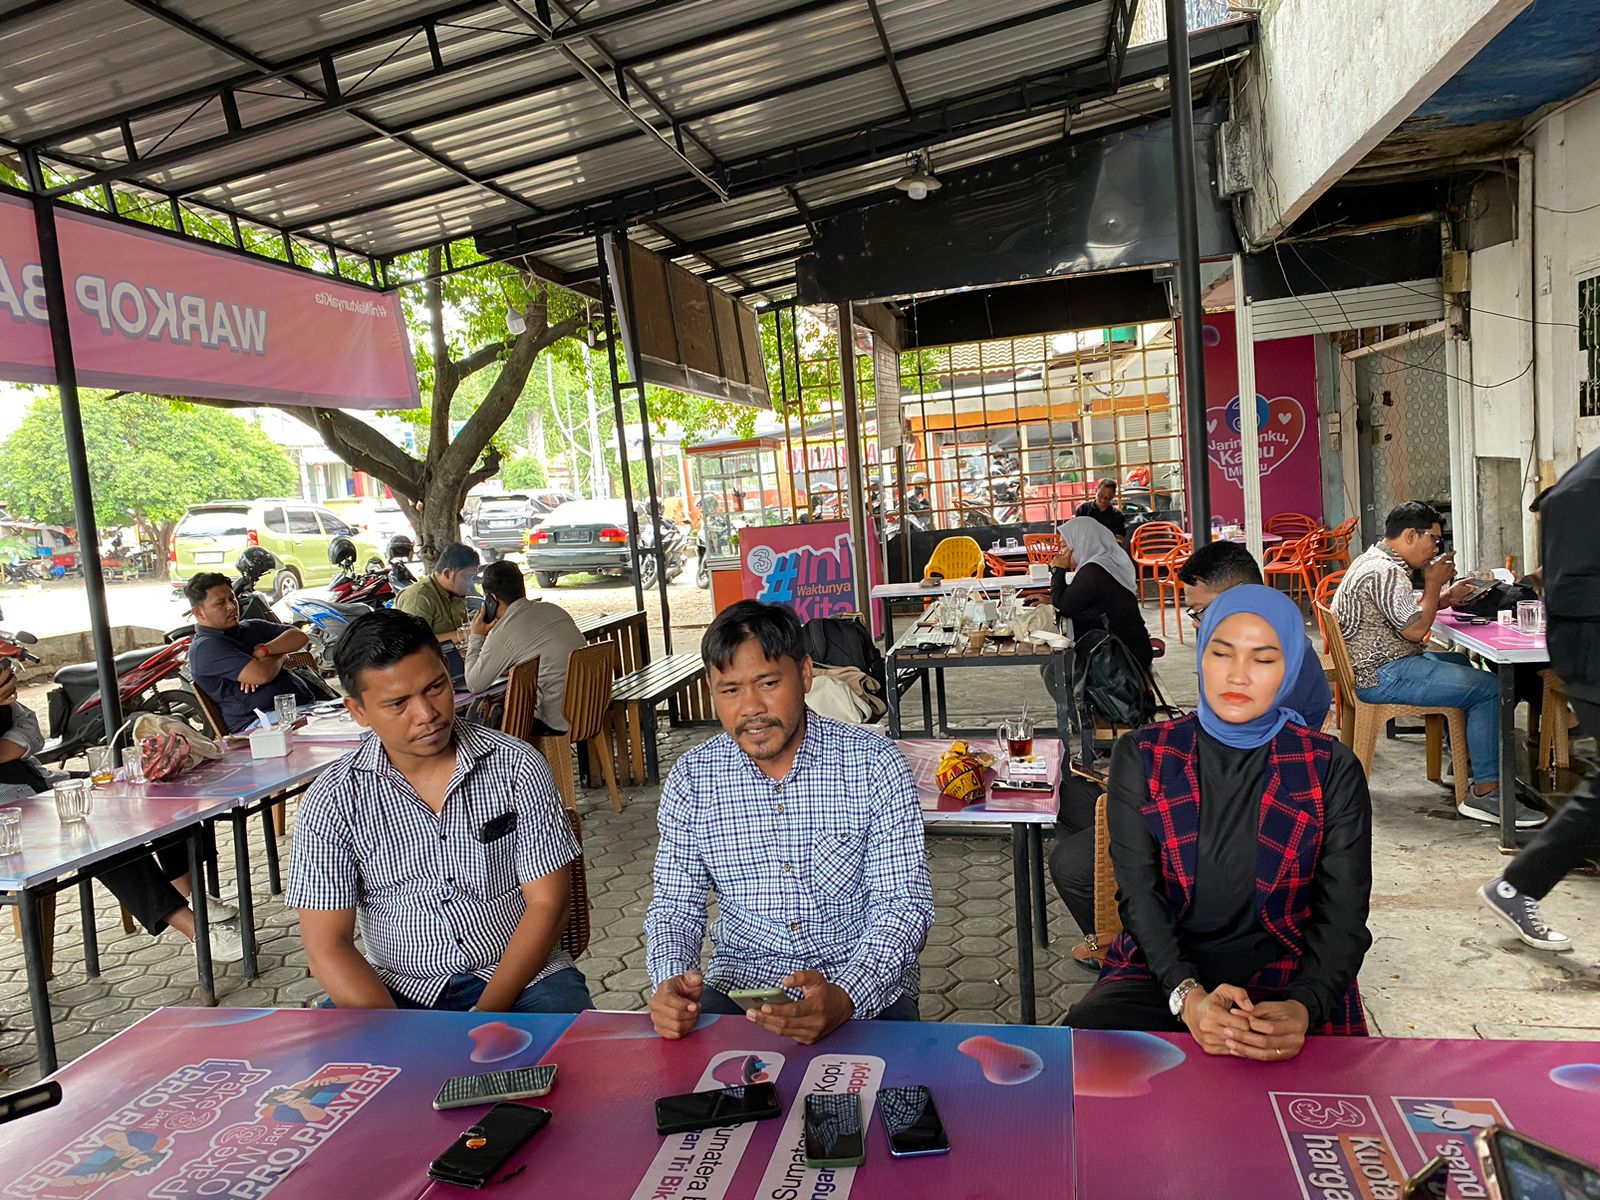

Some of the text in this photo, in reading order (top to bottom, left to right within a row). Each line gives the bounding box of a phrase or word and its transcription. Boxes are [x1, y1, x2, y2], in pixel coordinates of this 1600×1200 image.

[1207, 429, 1289, 450] Jarinnku,
[797, 582, 851, 596] Waktunya
[170, 1071, 232, 1109] OTW
[195, 1072, 260, 1110] Pake
[845, 1062, 871, 1094] appy!
[16, 1069, 205, 1192] PRO PLAYER
[227, 1069, 391, 1200] PRO PLAYER
[771, 1062, 847, 1200] Sumat Kopi,
[164, 1146, 237, 1194] Pake
[196, 1124, 294, 1196] OTW jadi
[667, 1154, 696, 1172] Tri
[1302, 1134, 1355, 1200] harga
[1348, 1136, 1400, 1200] Kuota
